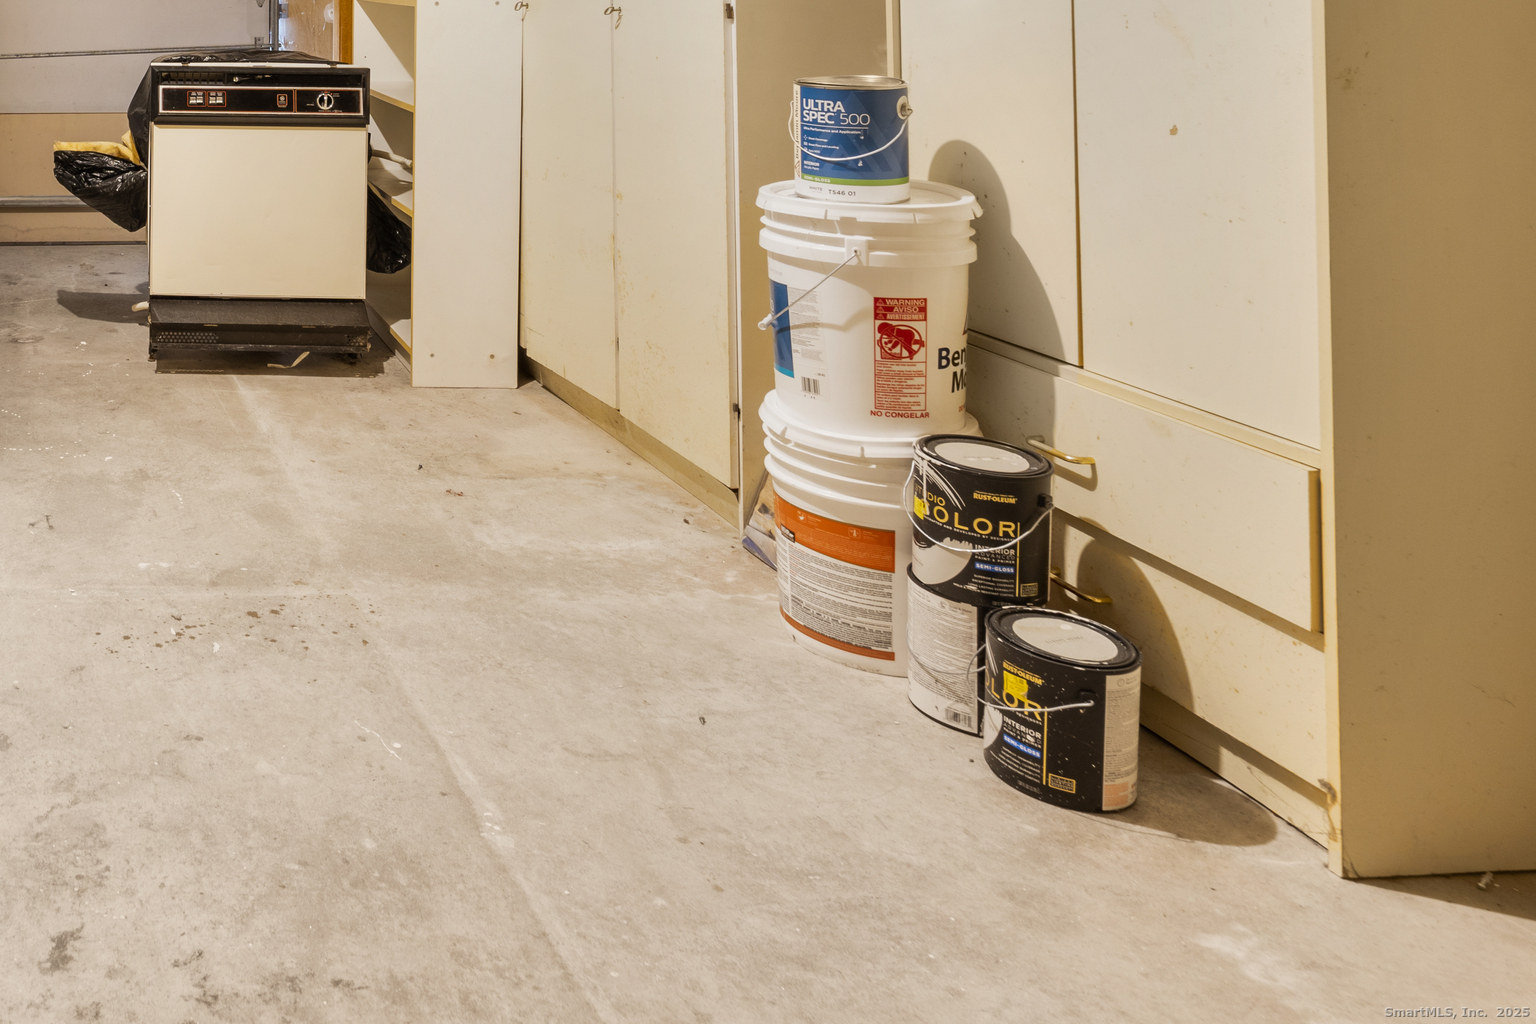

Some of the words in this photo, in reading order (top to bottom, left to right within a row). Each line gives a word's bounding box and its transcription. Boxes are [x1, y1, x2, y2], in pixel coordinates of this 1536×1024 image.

[802, 97, 846, 113] ULTRA
[802, 110, 835, 124] SPEC
[839, 113, 871, 126] 500
[885, 298, 925, 306] WARNING
[884, 411, 930, 419] CONGELAR
[914, 482, 946, 506] STDIO
[921, 498, 1016, 538] OLOR
[975, 563, 1015, 573] SEMI-GLOSS
[1003, 715, 1042, 739] INTERIOR
[1004, 723, 1042, 744] ADVAND
[1004, 735, 1041, 758] SEMI-GLOSS
